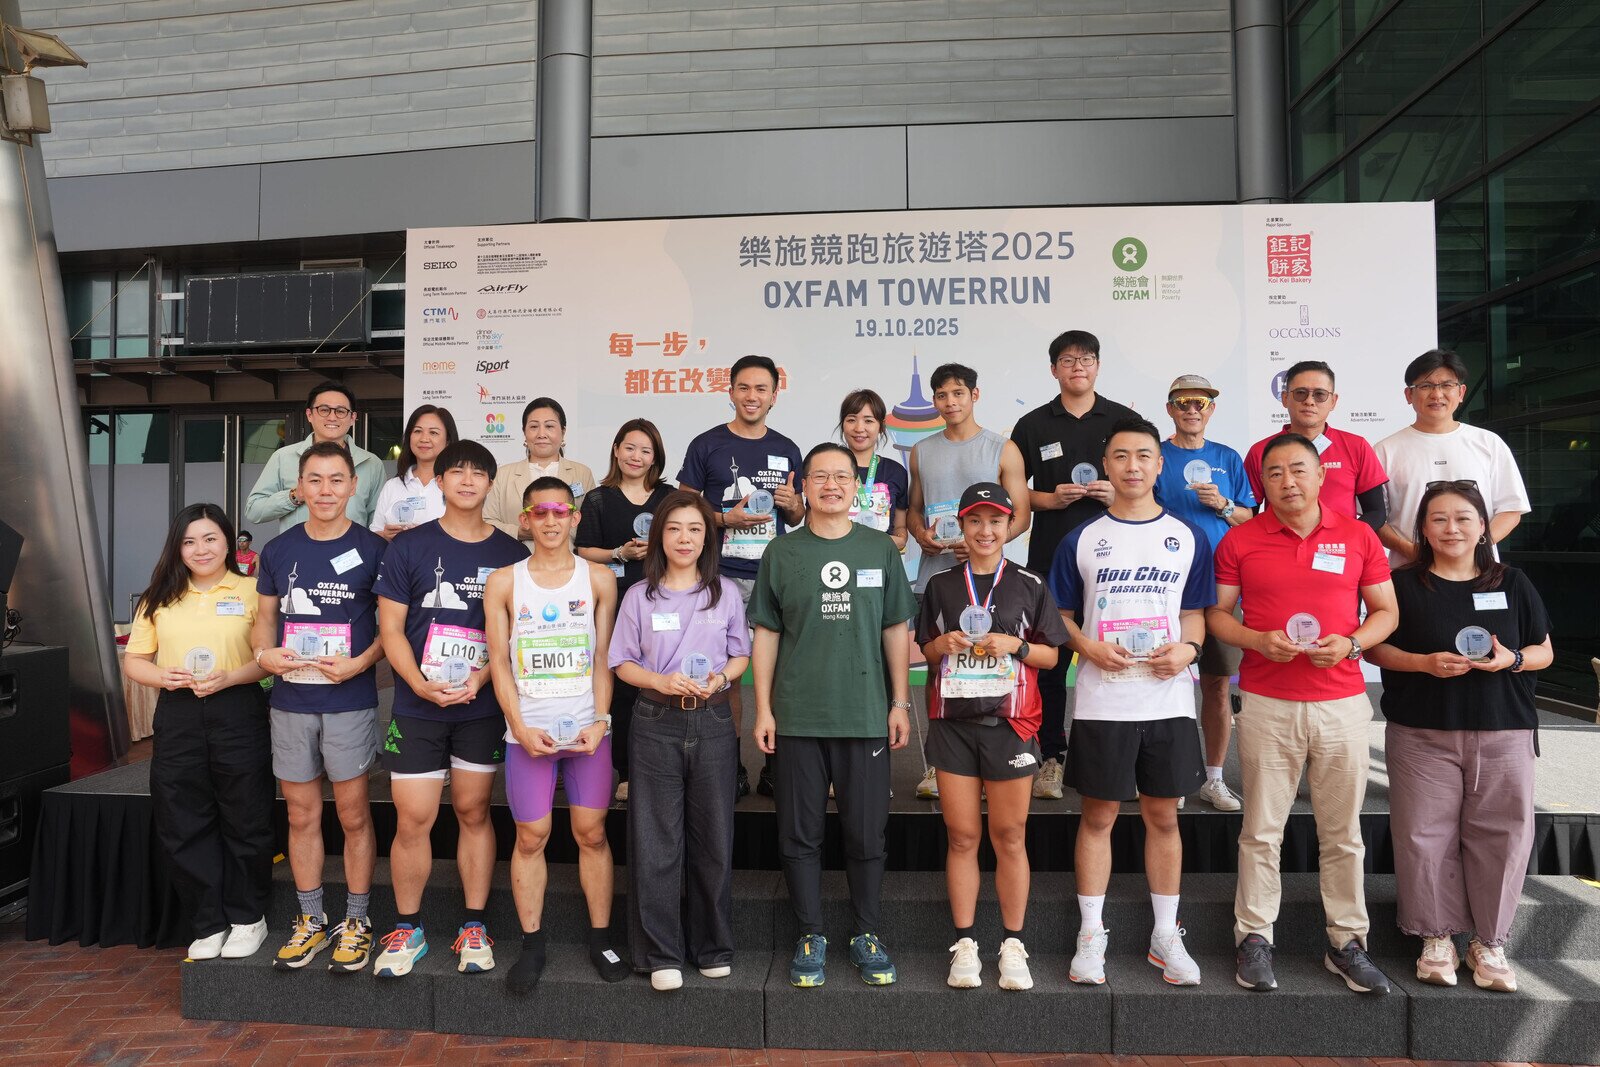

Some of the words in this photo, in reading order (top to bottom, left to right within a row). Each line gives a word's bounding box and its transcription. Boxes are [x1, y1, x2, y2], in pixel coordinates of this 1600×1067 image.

[739, 230, 1076, 268] 樂施競跑旅遊塔2025
[1269, 236, 1309, 253] 鉅記
[423, 261, 457, 270] SEIKO
[1270, 258, 1309, 275] 餅家
[1113, 275, 1149, 288] 樂施會
[477, 284, 528, 293] AirFly
[764, 278, 868, 308] OXFAM
[878, 276, 1051, 307] TOWERRUN
[1112, 290, 1149, 300] OXFAM
[423, 308, 446, 316] CTM
[855, 317, 959, 337] 19.10.2025
[1269, 327, 1341, 339] OCCASIONS
[608, 332, 708, 357] 每一步，
[423, 361, 455, 371] mome
[476, 360, 510, 374] iSport
[625, 366, 788, 394] 都在改變
[1096, 568, 1132, 584] Hou
[1134, 566, 1180, 583] Chon
[317, 582, 348, 591] OXFAM
[455, 584, 486, 592] TOWER
[1110, 585, 1167, 594] BASKETBALL
[308, 589, 355, 599] TOWERRUN
[822, 591, 851, 602] 樂施會
[821, 603, 851, 613] OXFAM
[441, 642, 476, 660] L010
[532, 652, 573, 669] EM01
